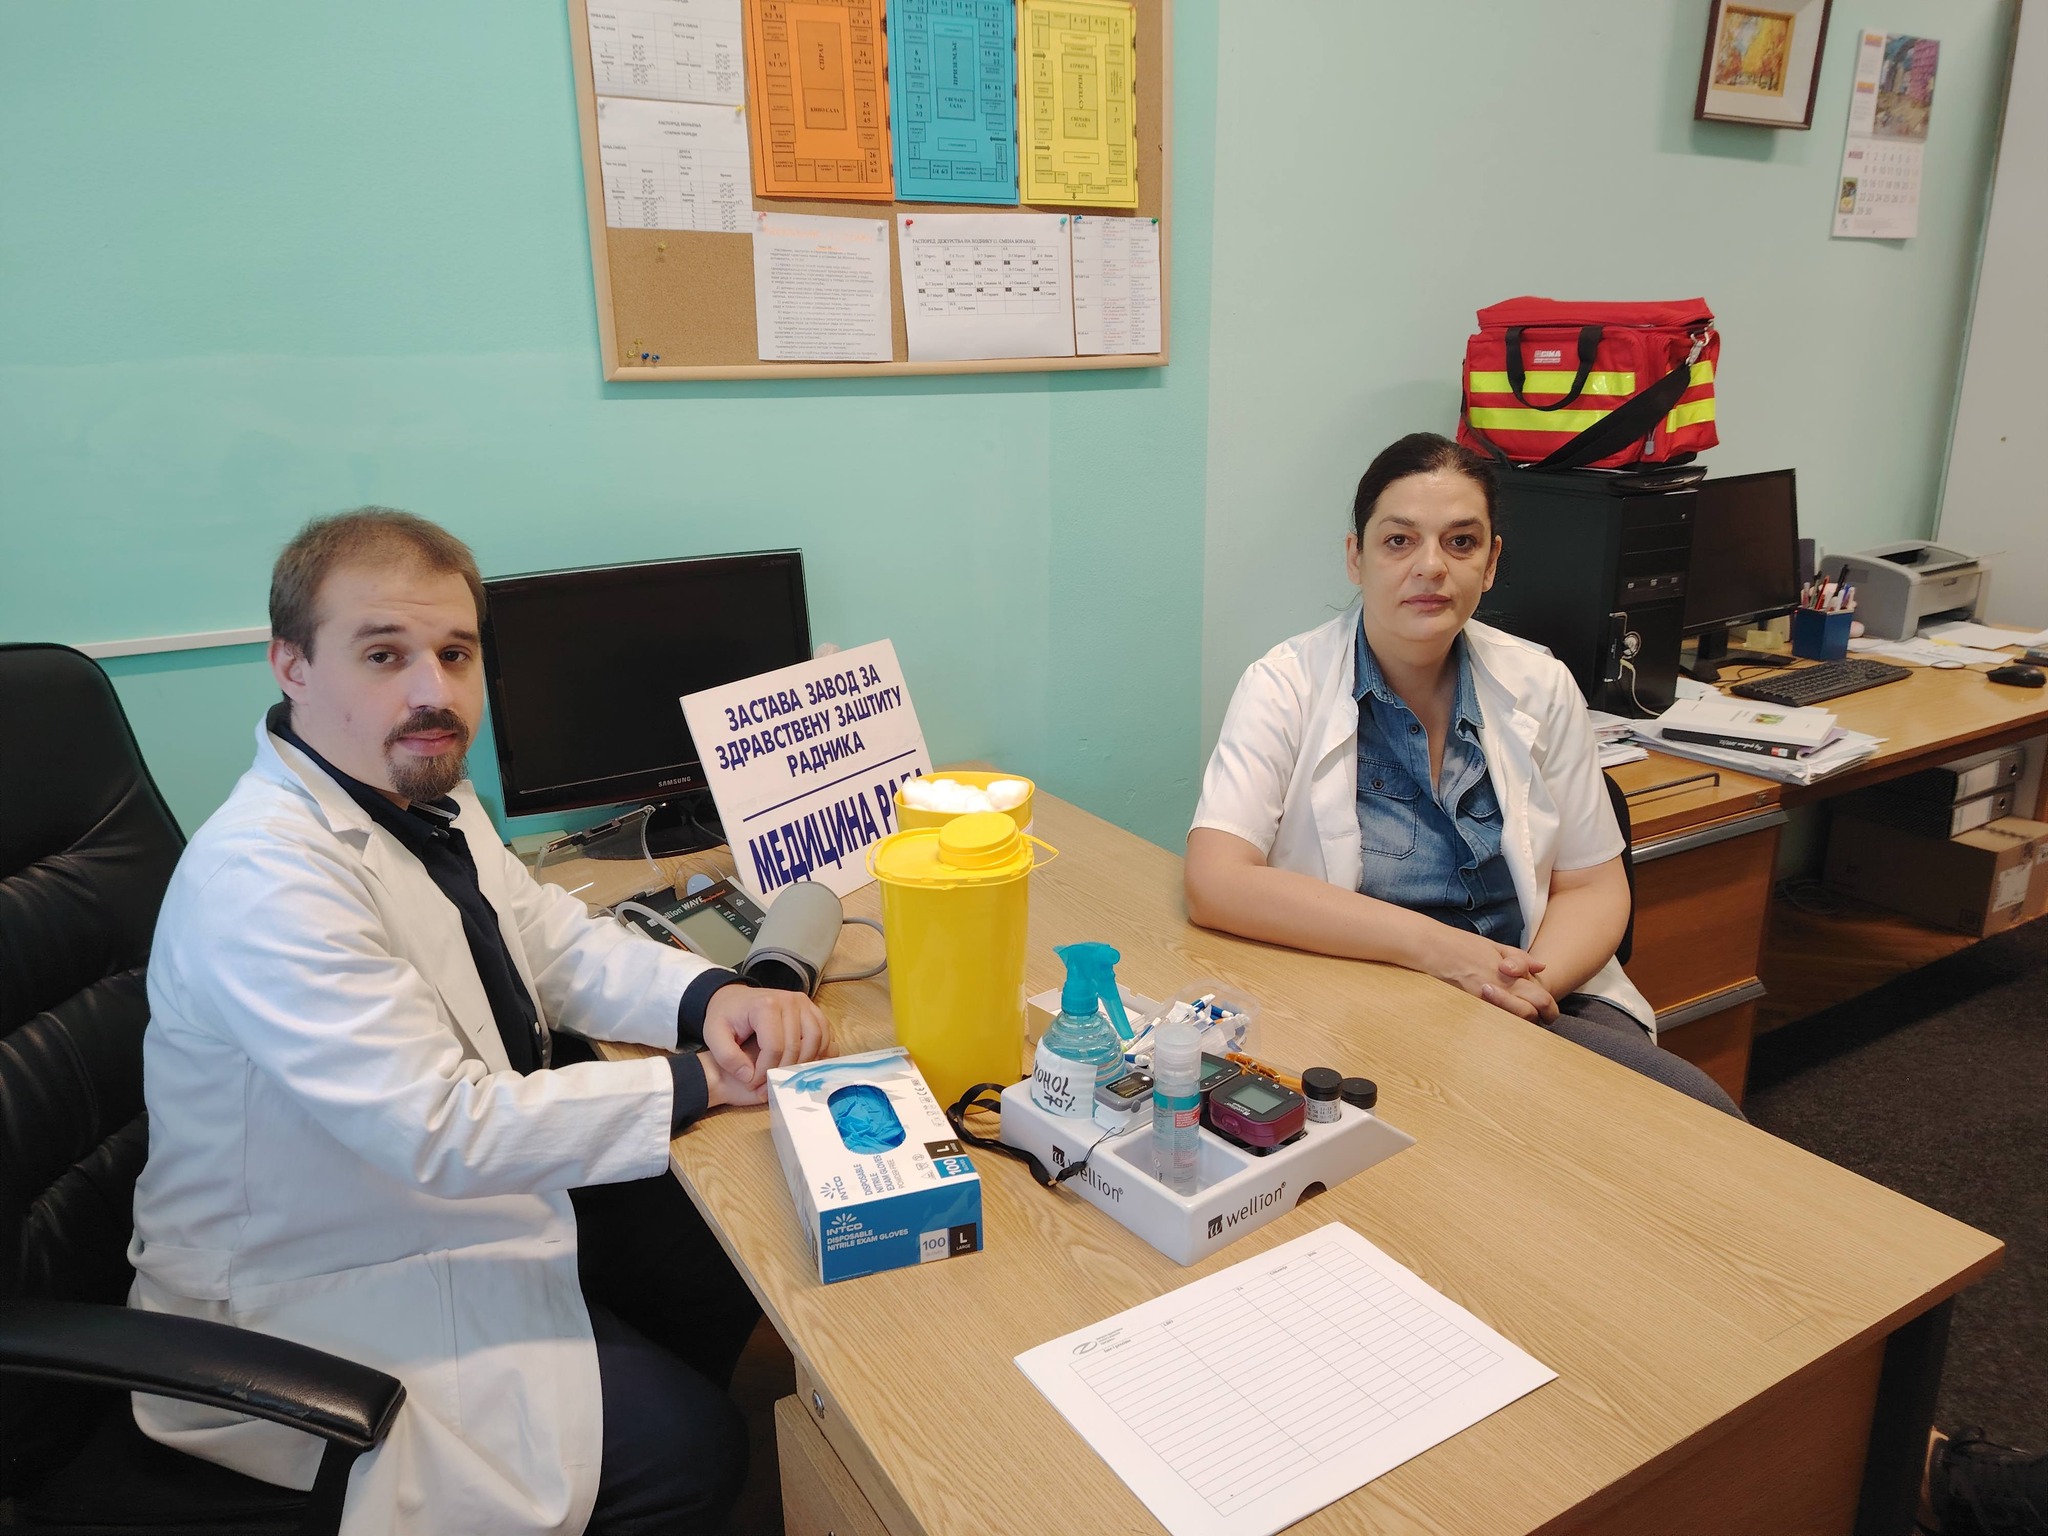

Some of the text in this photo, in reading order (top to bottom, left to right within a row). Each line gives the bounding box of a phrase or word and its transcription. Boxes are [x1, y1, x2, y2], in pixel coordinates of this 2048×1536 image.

[725, 664, 881, 731] ЗАСТАВА ЗАВОД ЗА
[715, 685, 902, 771] ЗДРАВСТВЕНУ ЗАШТИТУ
[786, 731, 865, 778] РАДНИКА
[658, 776, 691, 788] SAMSUNG
[749, 792, 881, 895] МЕДИЦИНА
[663, 908, 682, 920] ellion
[681, 896, 704, 911] WAVE
[1044, 1091, 1076, 1112] 70%
[936, 1145, 950, 1153] L
[873, 1155, 895, 1191] EXAM GLOVES
[943, 1159, 961, 1176] 100
[833, 1176, 849, 1200] INTCO
[853, 1163, 873, 1196] DISPOSABLE
[870, 1173, 884, 1193] NITRILE
[826, 1222, 863, 1236] INTCO
[826, 1229, 873, 1245] DISPOSABLE
[827, 1228, 909, 1251] NITRILE EXAM GLOVES
[959, 1232, 968, 1244] L
[922, 1237, 946, 1250] 100
[956, 1243, 971, 1251] LARGE
